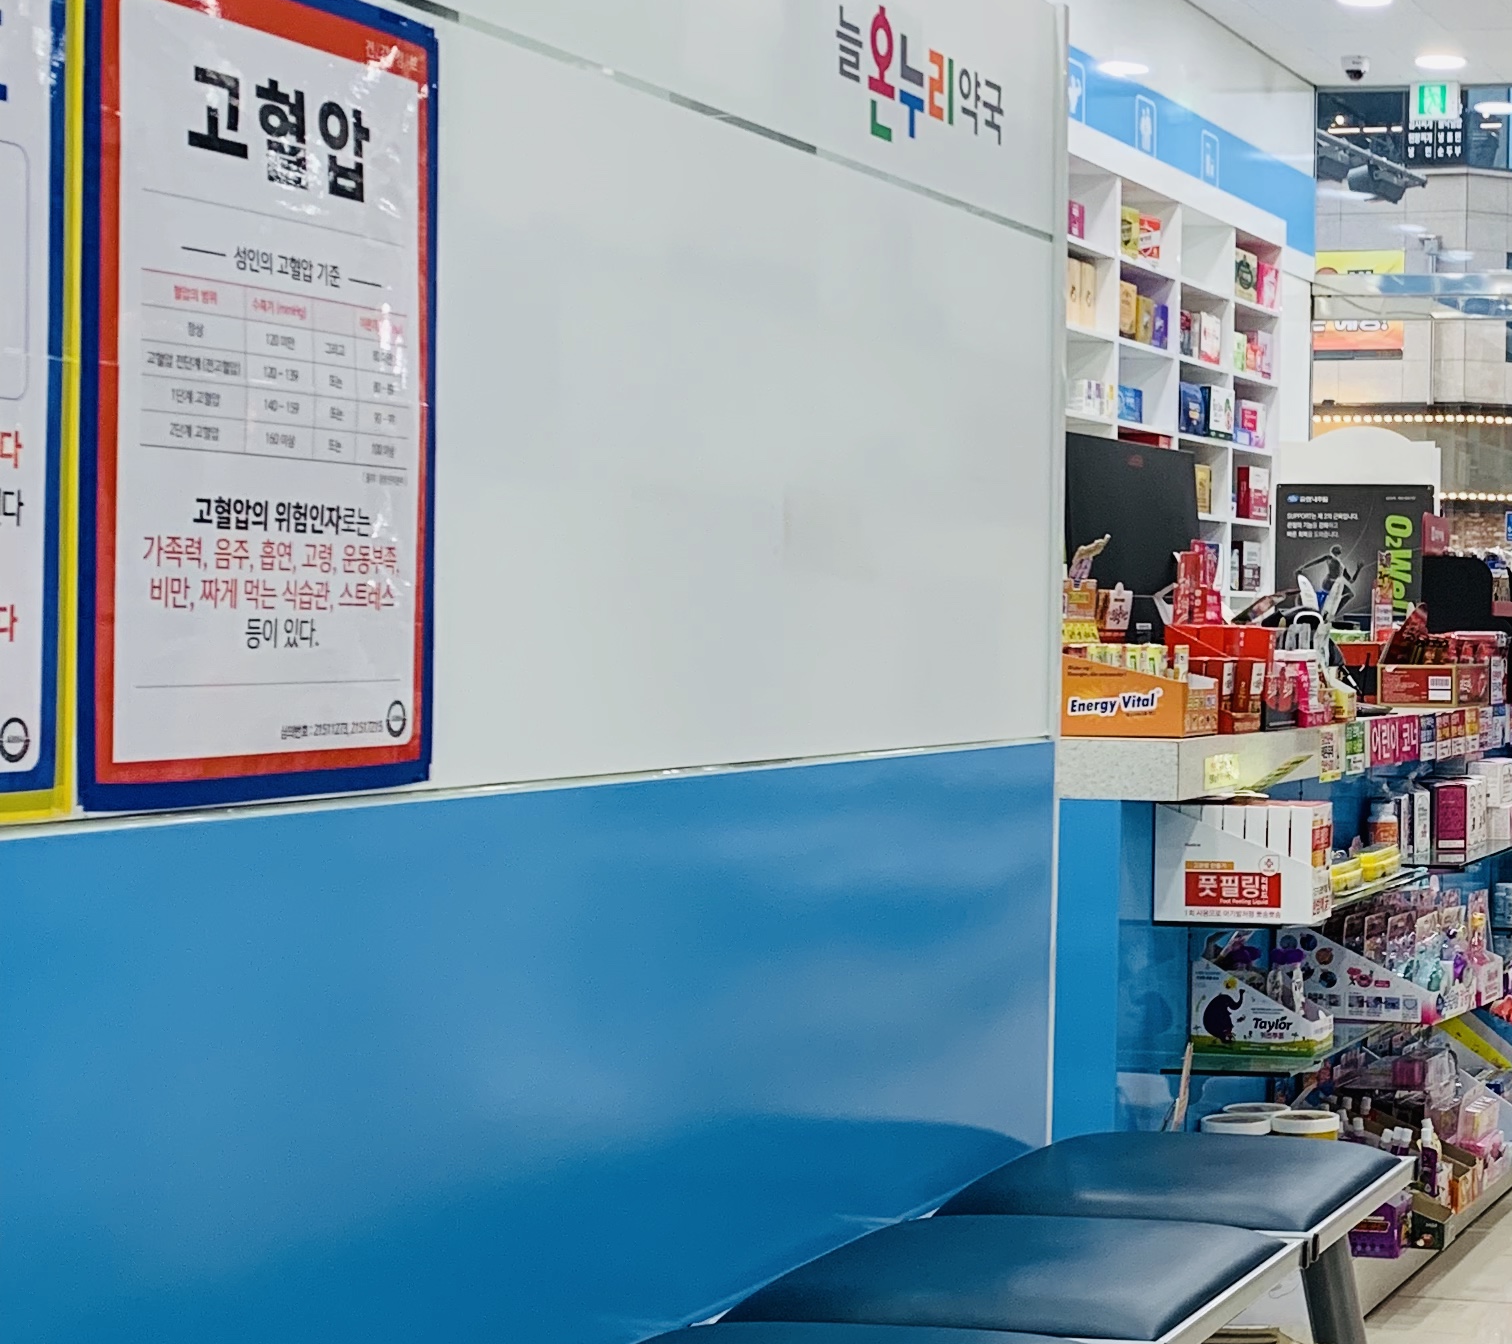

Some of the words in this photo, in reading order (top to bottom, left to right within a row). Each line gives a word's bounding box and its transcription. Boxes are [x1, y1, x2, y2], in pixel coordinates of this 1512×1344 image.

[836, 5, 1004, 145] 늘온누리약국
[188, 66, 370, 202] 고혈압
[234, 246, 273, 274] 성인의
[277, 255, 313, 282] 고혈압
[317, 264, 342, 288] 기준
[195, 389, 221, 407] 고혈압
[194, 425, 220, 442] 고혈압
[193, 497, 268, 532] 고혈압의
[275, 502, 371, 537] 위험인자로는
[143, 535, 207, 570] 가족력,
[214, 539, 254, 572] 음주,
[260, 540, 296, 573] 흡연,
[301, 544, 337, 575] 고령,
[342, 545, 400, 575] 운동부족,
[150, 576, 194, 612] 비만,
[200, 578, 237, 610] 짜게
[244, 579, 277, 610] 먹는
[282, 580, 333, 613] 식습관,
[338, 582, 395, 611] 스트레스
[245, 618, 278, 649] 등이
[283, 618, 320, 649] 있다.
[1070, 699, 1117, 714] Energy
[1122, 693, 1155, 709] Vital
[1371, 720, 1399, 761] 어린이
[1401, 719, 1419, 752] 코너
[1198, 874, 1260, 898] 풋필링
[1253, 1016, 1293, 1033] Taylor
